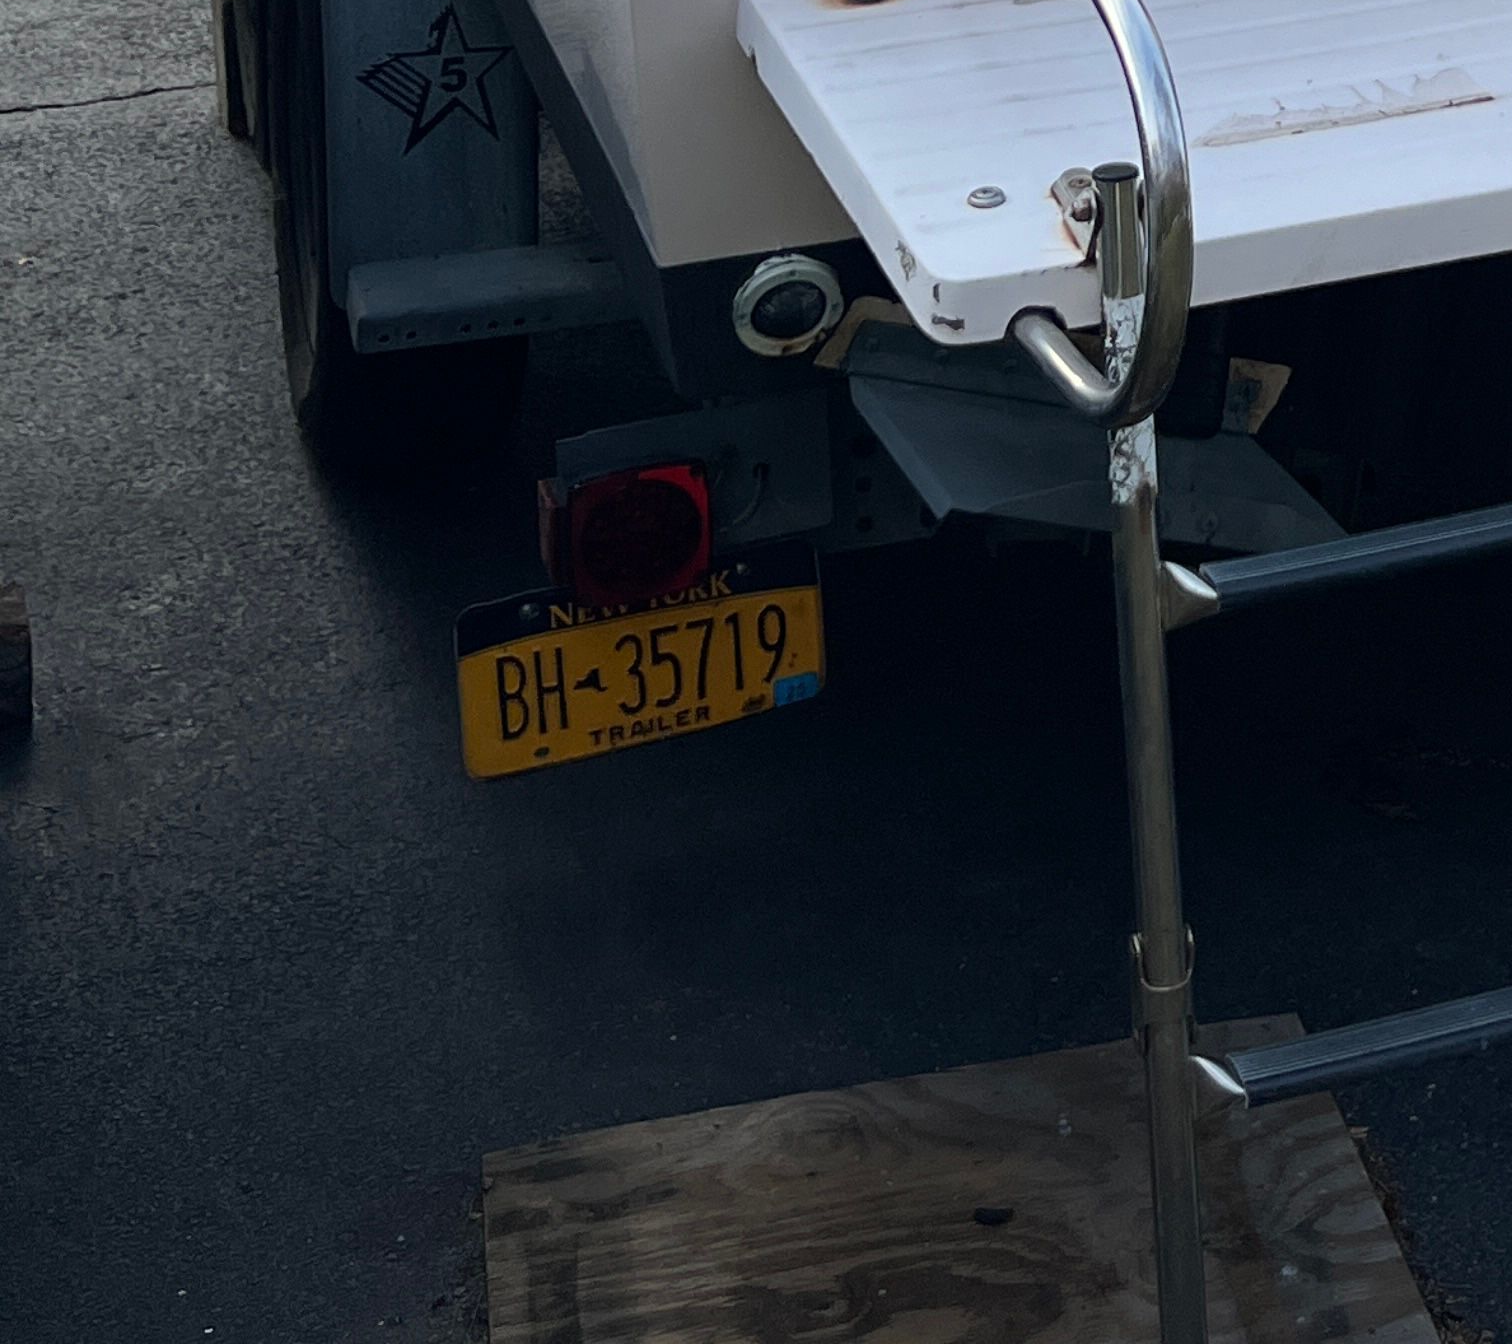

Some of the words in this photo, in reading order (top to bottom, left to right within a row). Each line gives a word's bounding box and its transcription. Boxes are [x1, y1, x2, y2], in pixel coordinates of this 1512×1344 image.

[440, 57, 468, 93] 5
[496, 647, 569, 742] BH
[614, 605, 786, 715] 35719
[589, 706, 711, 746] TRAILER
